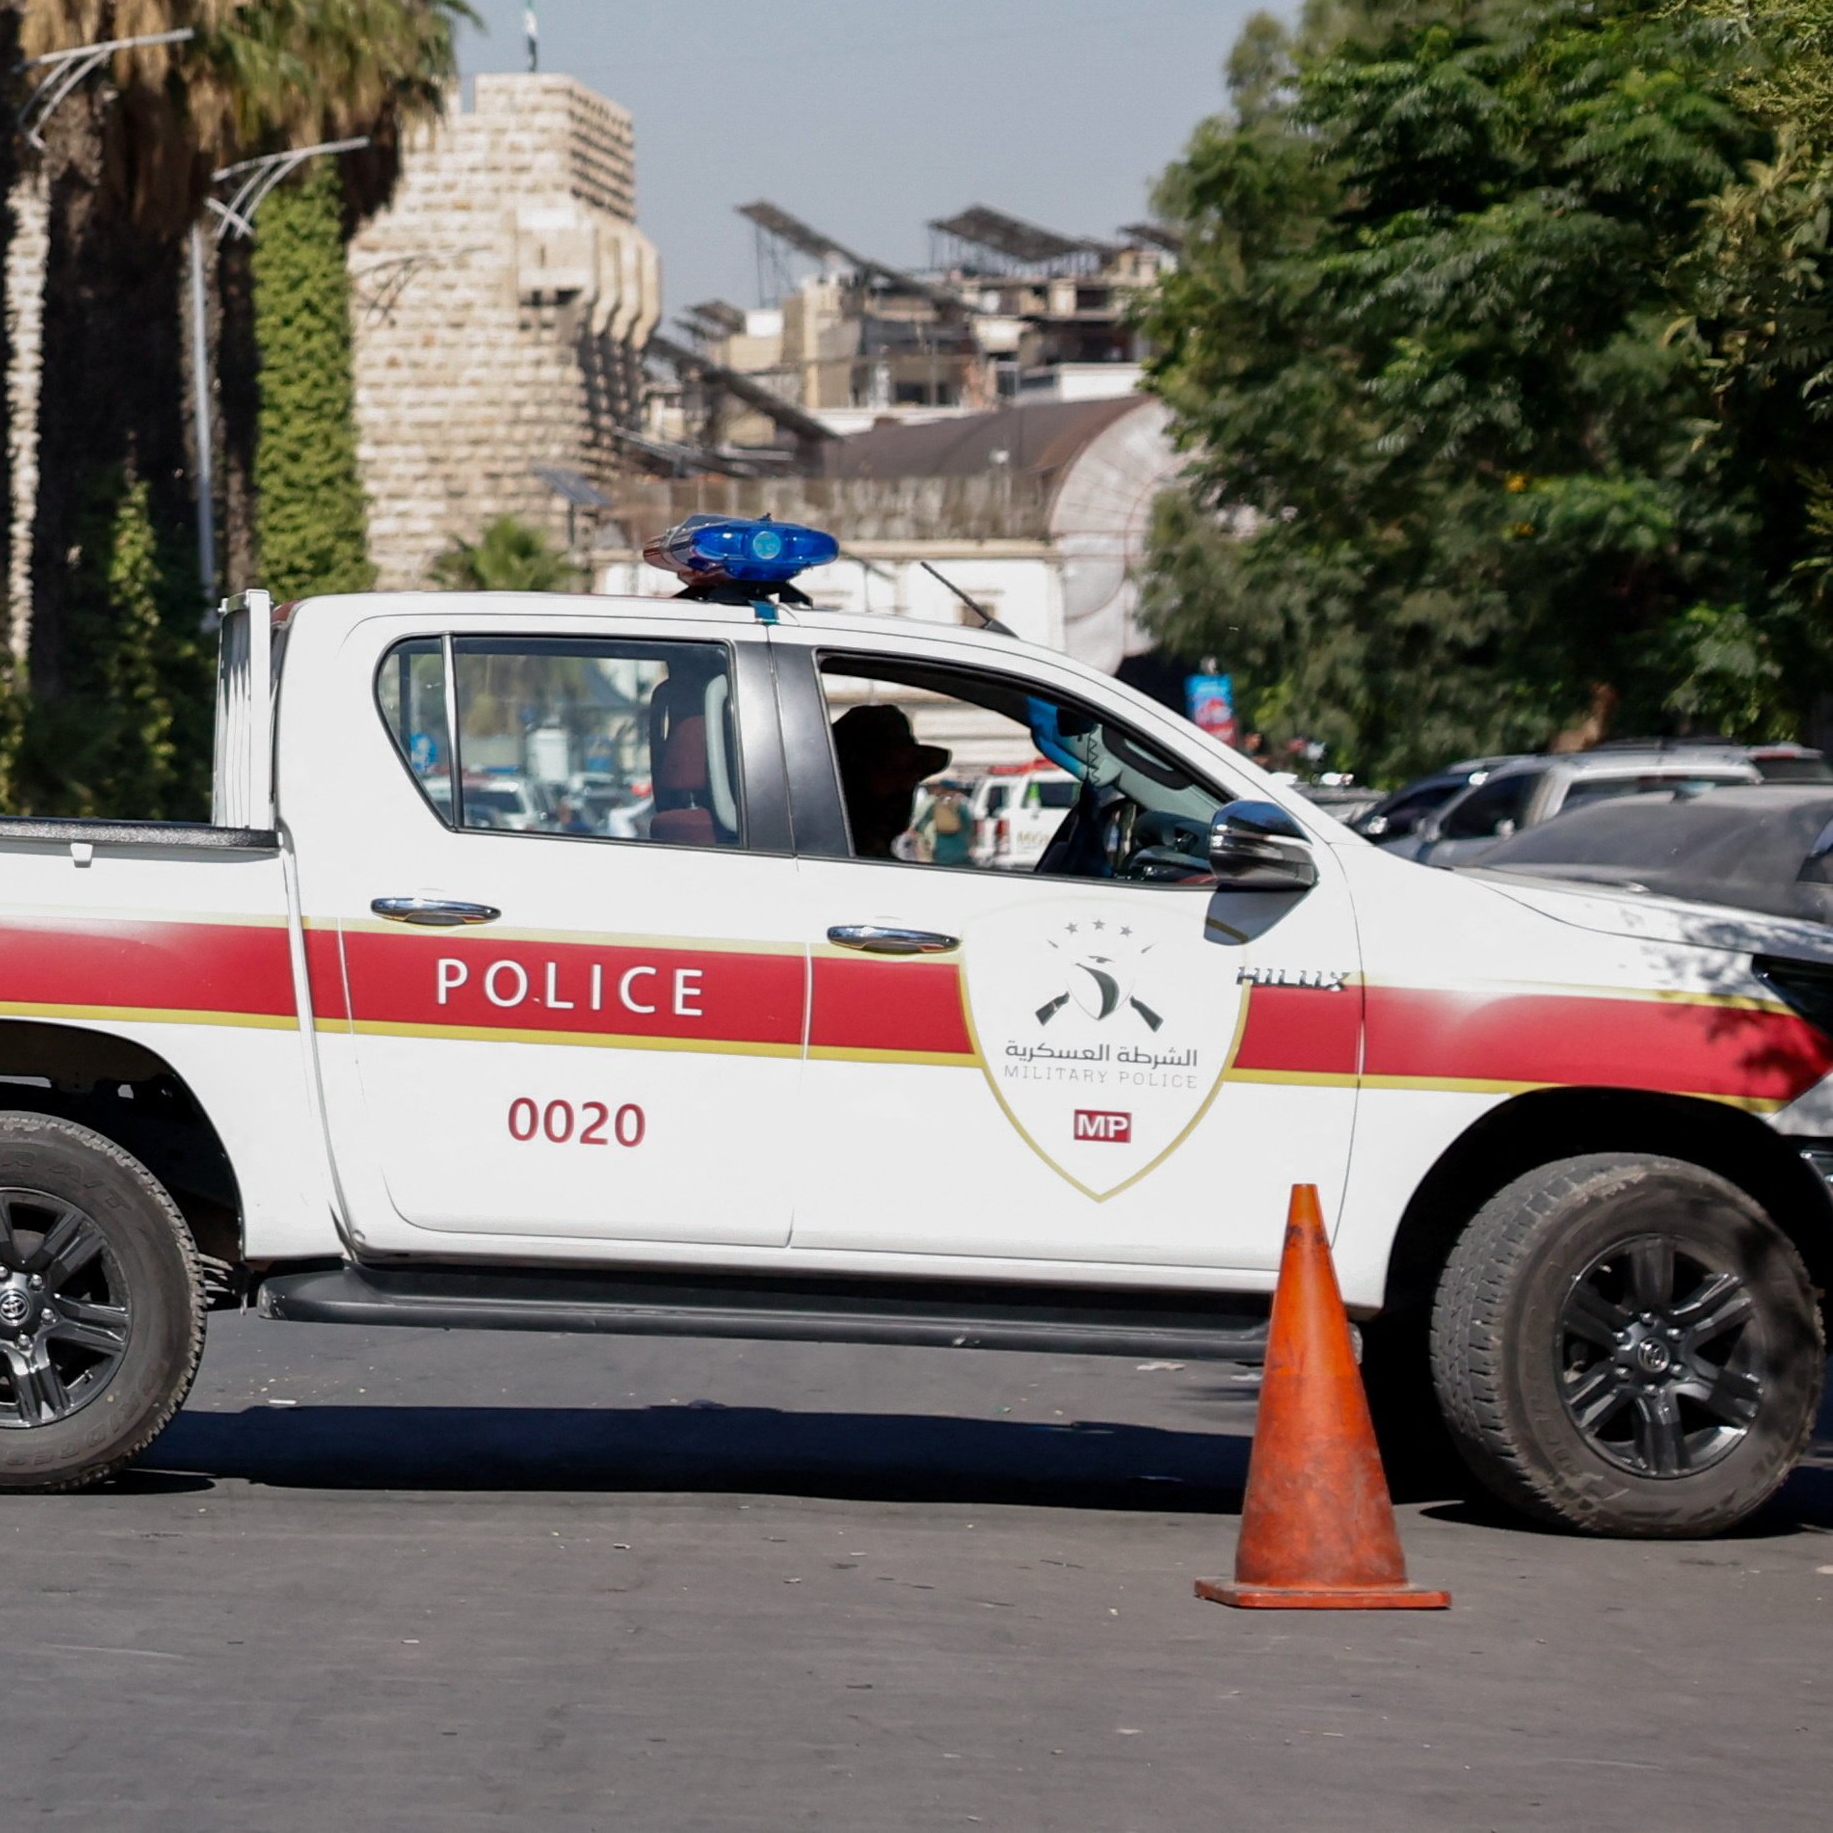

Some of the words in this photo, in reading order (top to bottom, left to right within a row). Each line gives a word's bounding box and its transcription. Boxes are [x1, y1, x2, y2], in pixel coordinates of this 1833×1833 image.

[436, 957, 703, 1016] POLICE
[1236, 966, 1350, 990] HILUX
[1005, 1039, 1110, 1062] العسكرية
[1117, 1046, 1198, 1070] الشرطة
[1004, 1064, 1108, 1083] MILITARY
[1118, 1070, 1198, 1089] POLICE
[508, 1097, 646, 1148] 0020
[1077, 1114, 1129, 1138] MP
